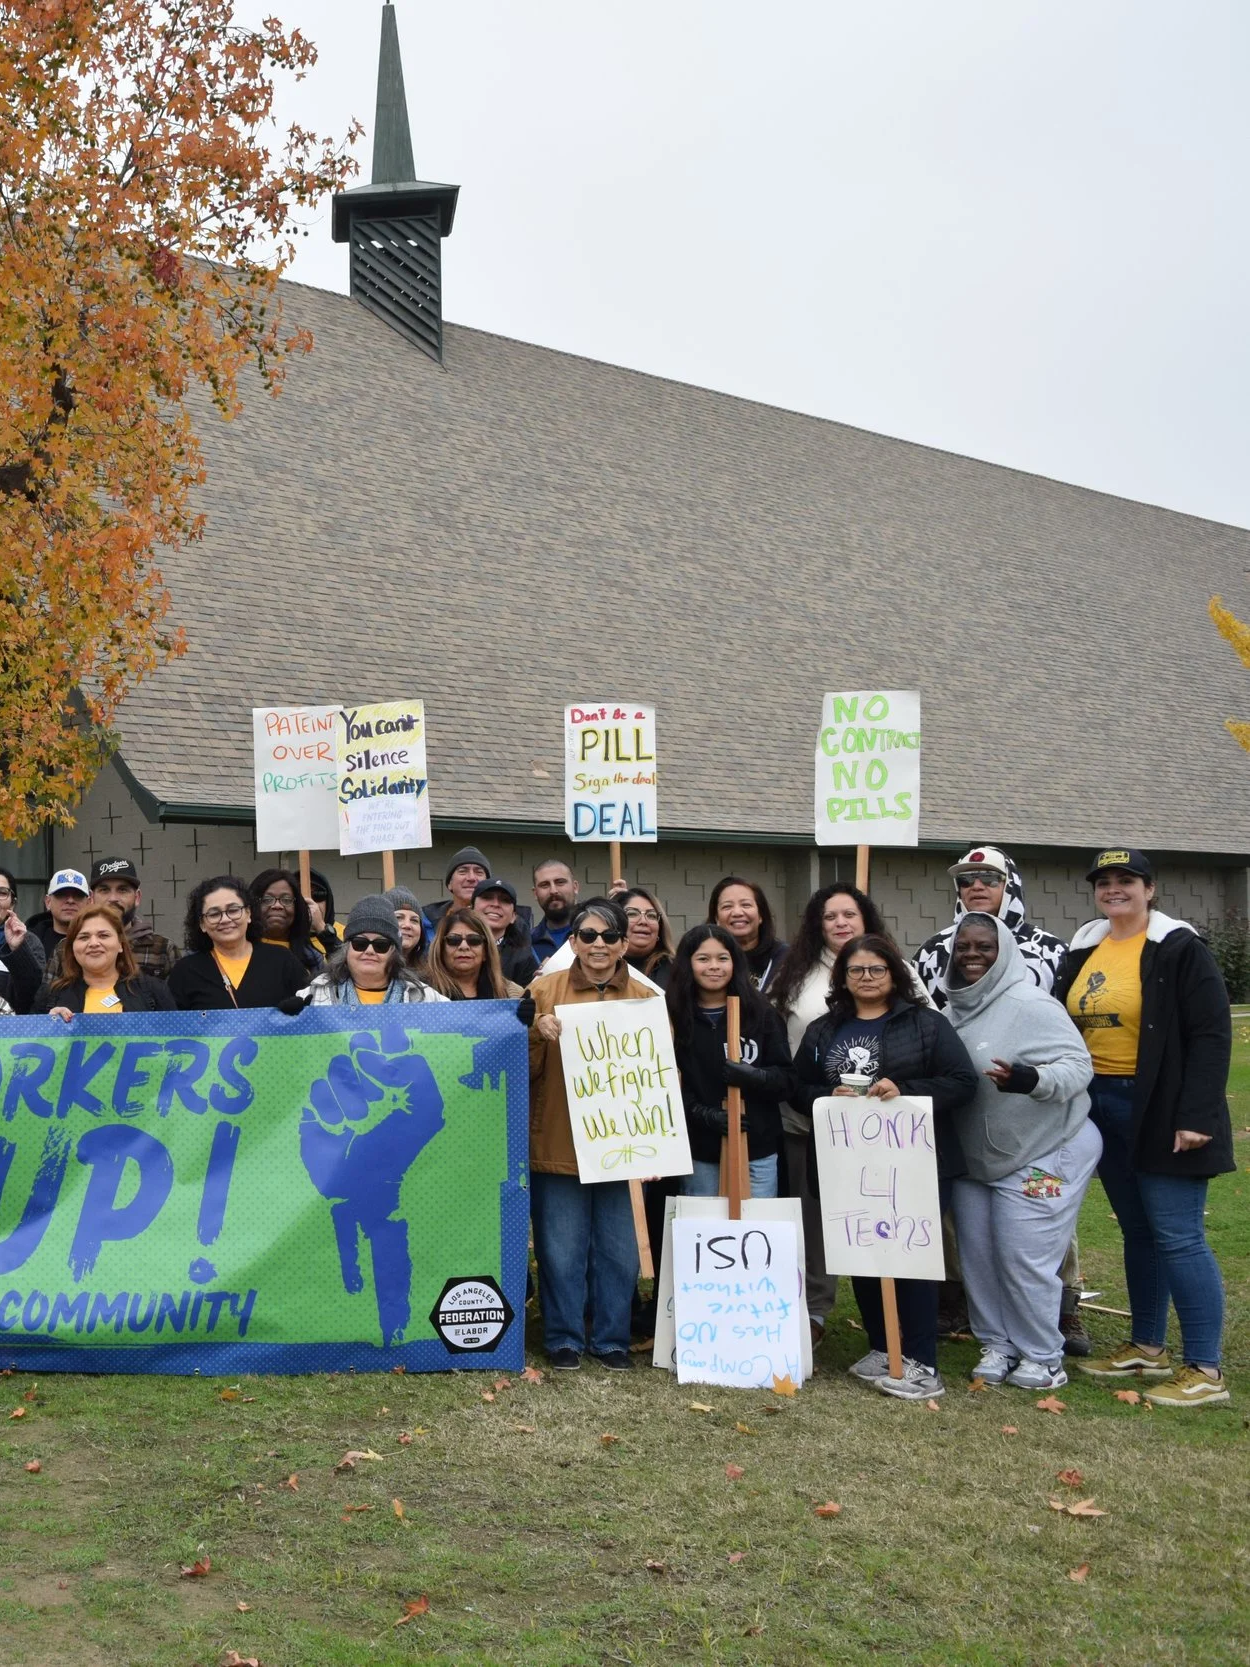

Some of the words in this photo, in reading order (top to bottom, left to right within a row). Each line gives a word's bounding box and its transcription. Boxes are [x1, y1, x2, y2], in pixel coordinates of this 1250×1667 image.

[832, 694, 889, 723] NO
[339, 710, 373, 744] You
[273, 742, 334, 761] OVER
[580, 727, 653, 762] PILL
[573, 773, 609, 794] Sign
[832, 758, 888, 791] NO
[574, 803, 656, 837] DEAL
[826, 792, 913, 823] PILLS
[576, 1021, 654, 1062] When
[827, 1109, 934, 1152] HONK
[860, 1165, 897, 1216] 4
[695, 1230, 772, 1274] US!
[448, 1292, 462, 1305] LOS
[463, 1288, 495, 1304] ANGELES
[439, 1310, 505, 1324] FEDERATION
[462, 1327, 488, 1335] LABOR
